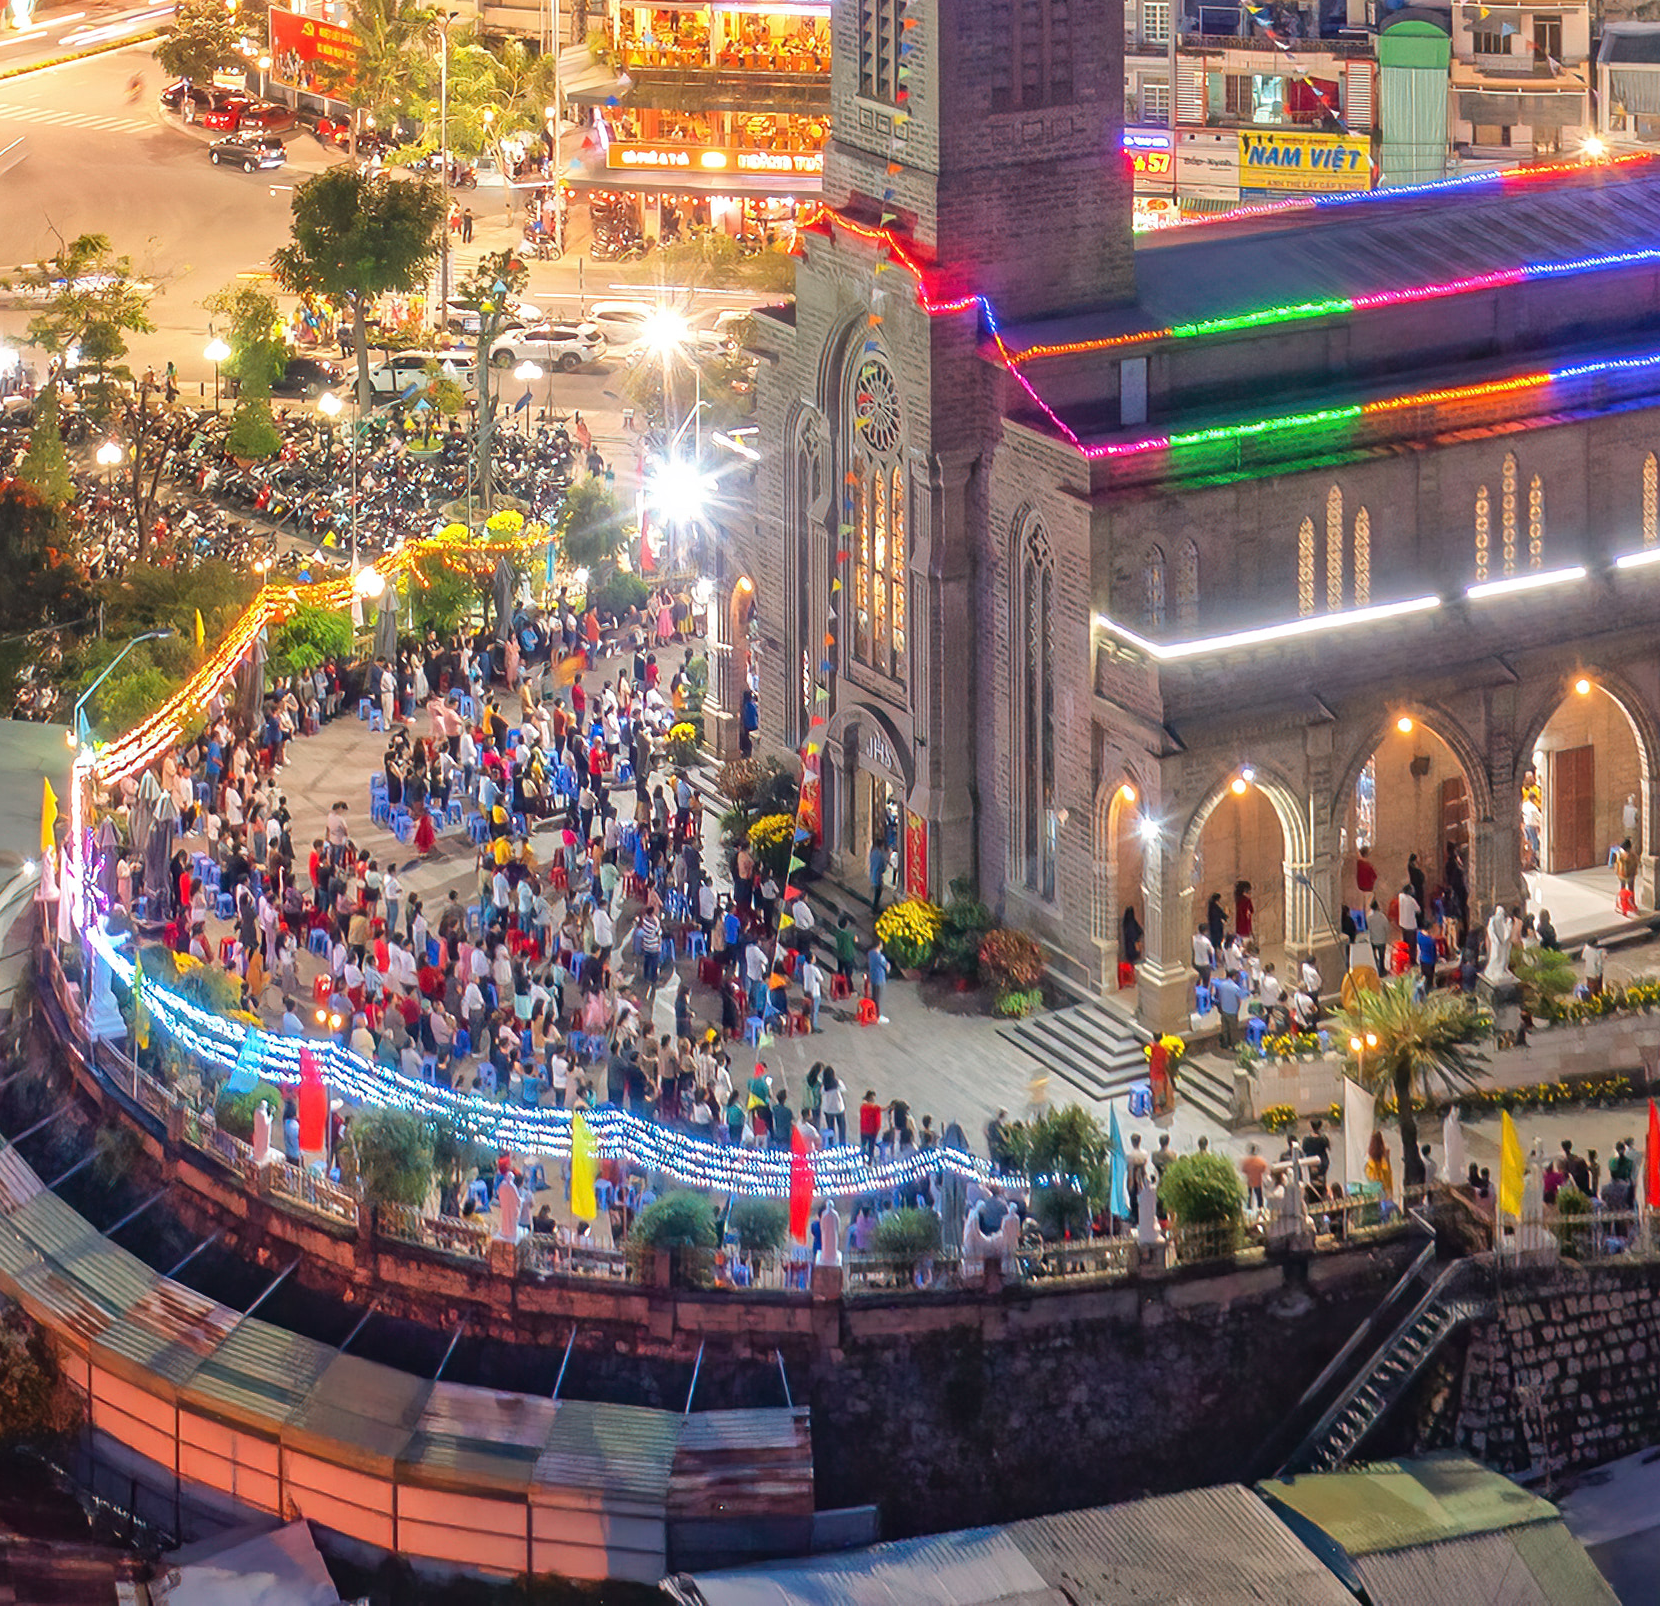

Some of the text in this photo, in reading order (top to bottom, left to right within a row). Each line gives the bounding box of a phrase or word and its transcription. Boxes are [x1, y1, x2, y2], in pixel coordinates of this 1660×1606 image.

[1148, 153, 1170, 173] 57
[1248, 145, 1362, 173] NAM VIỆT
